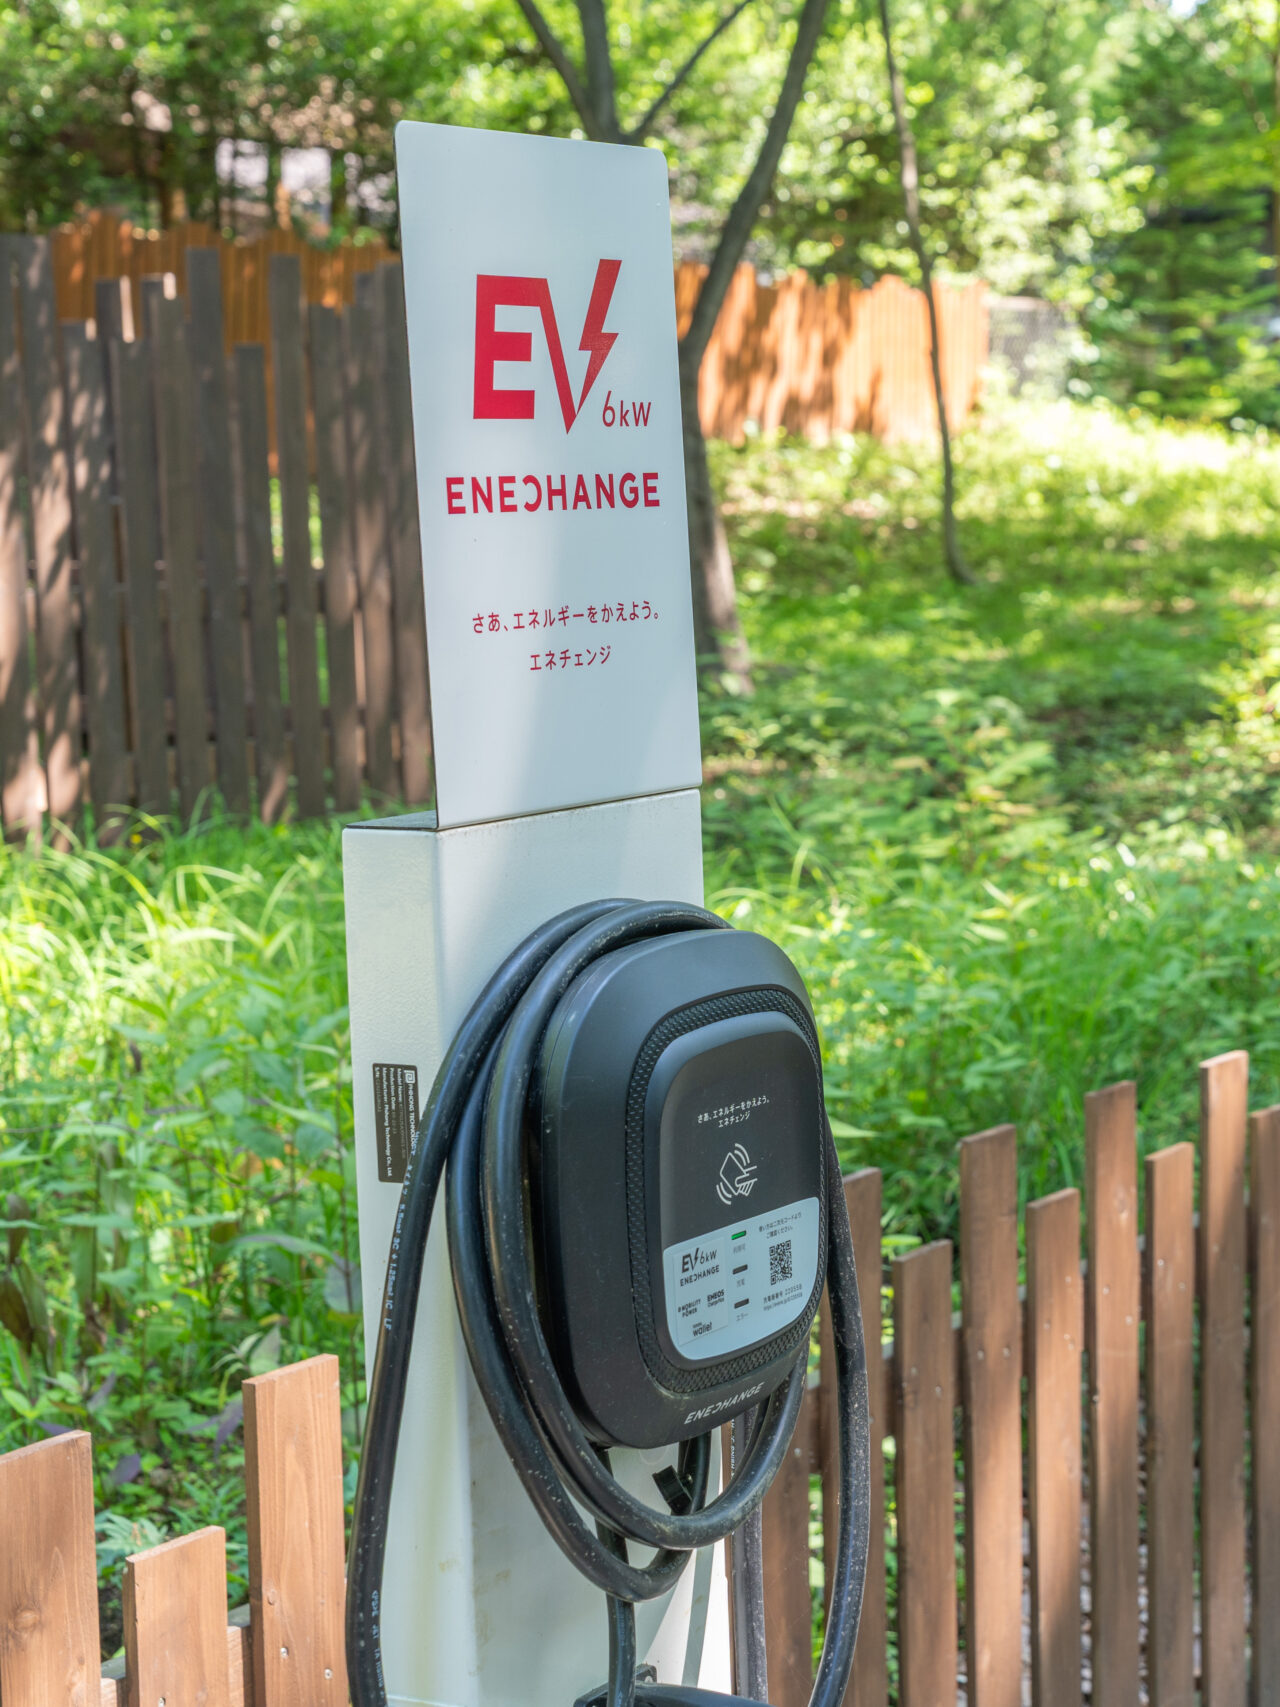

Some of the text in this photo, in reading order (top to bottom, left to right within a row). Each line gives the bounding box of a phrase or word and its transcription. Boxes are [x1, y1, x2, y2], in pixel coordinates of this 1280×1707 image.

[473, 258, 652, 435] EV 6kW
[446, 472, 660, 515] ENECHANGE
[471, 600, 660, 635] さあ、エネルギーをかえよう。
[529, 644, 612, 672] エネチェンジ
[718, 1111, 750, 1128] エネチェンジ
[681, 1247, 718, 1273] EV 6kW
[679, 1265, 720, 1287] ENECHANGE
[683, 1381, 765, 1425] ENECHANGE
